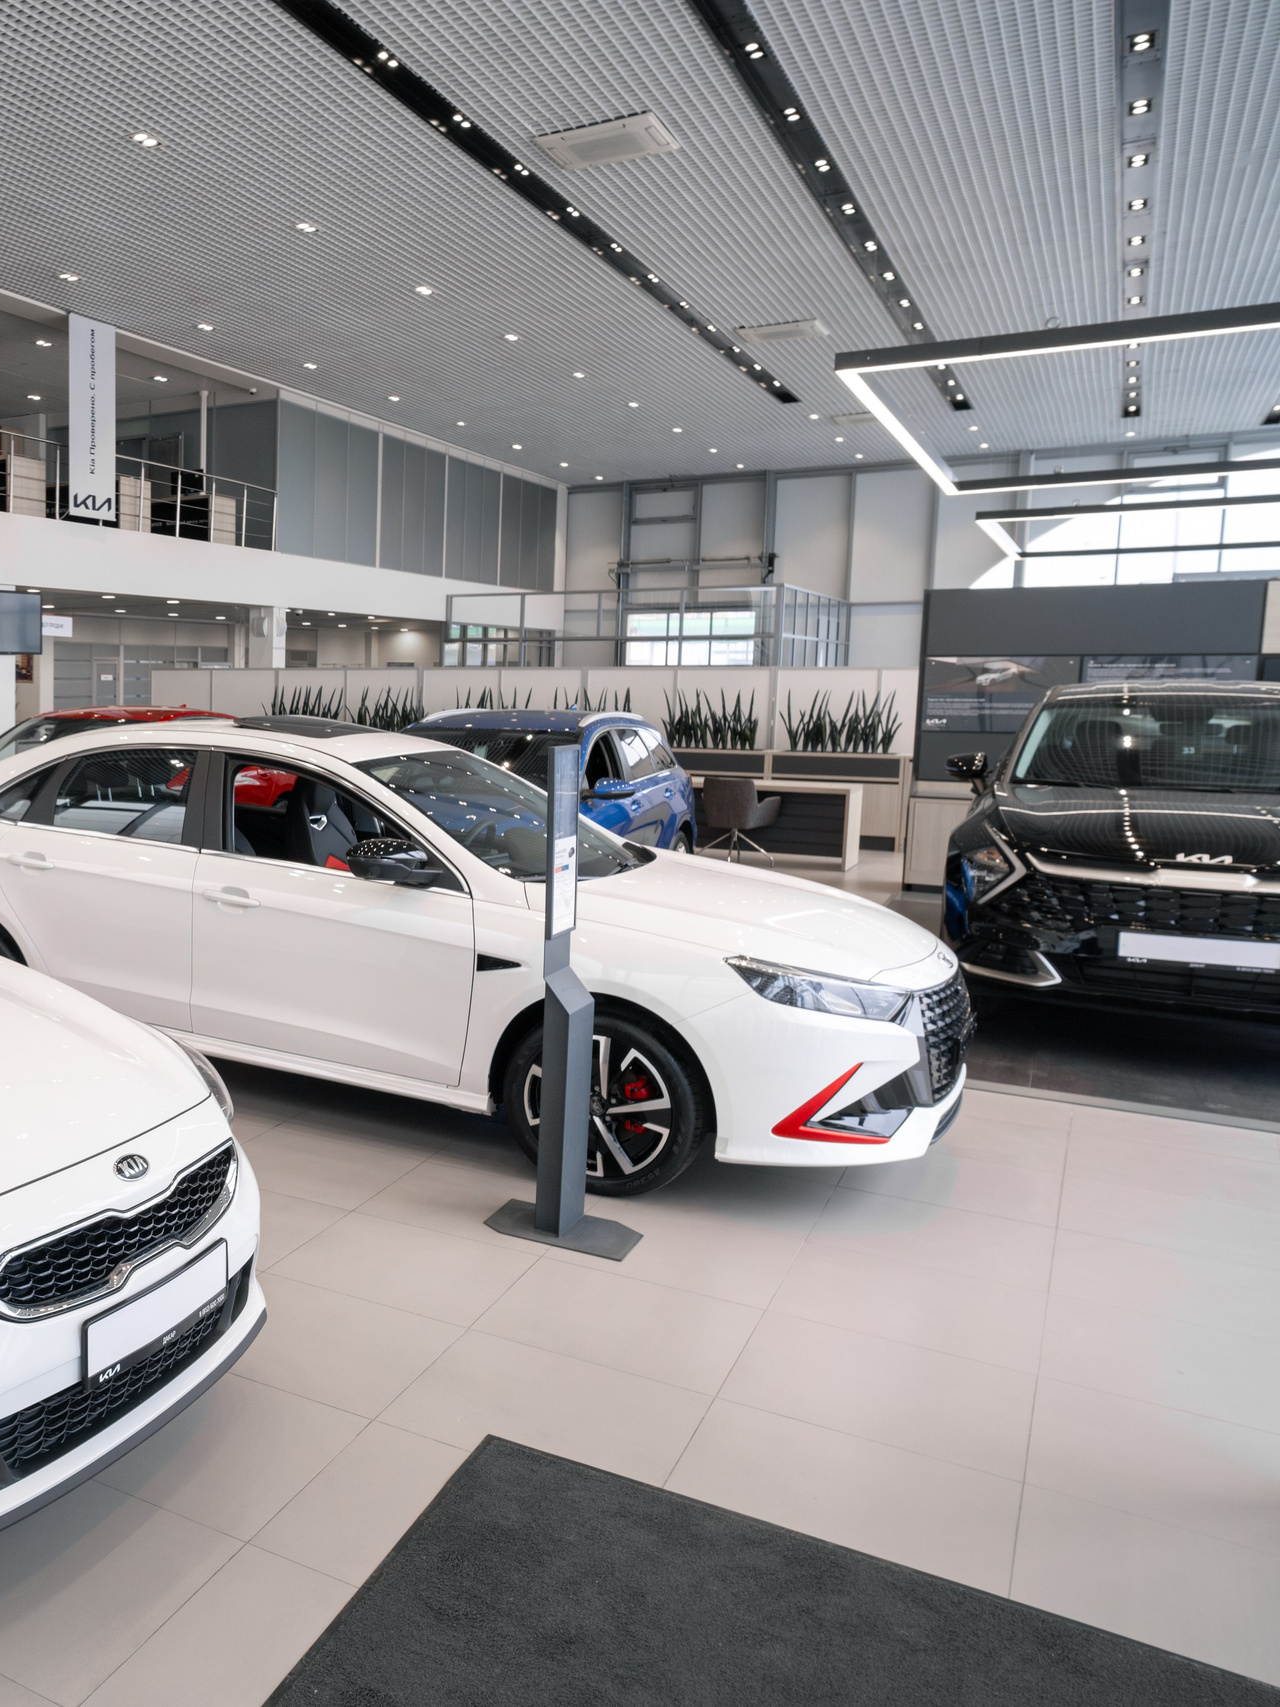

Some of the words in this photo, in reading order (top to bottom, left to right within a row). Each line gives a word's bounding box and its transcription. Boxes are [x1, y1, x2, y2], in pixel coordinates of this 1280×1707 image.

[89, 394, 97, 455] Проверено.
[73, 492, 112, 513] KIA
[1175, 852, 1234, 865] KIA
[117, 1155, 148, 1178] KIA
[162, 1330, 177, 1345] ДАКАР
[99, 1363, 121, 1383] KIA
